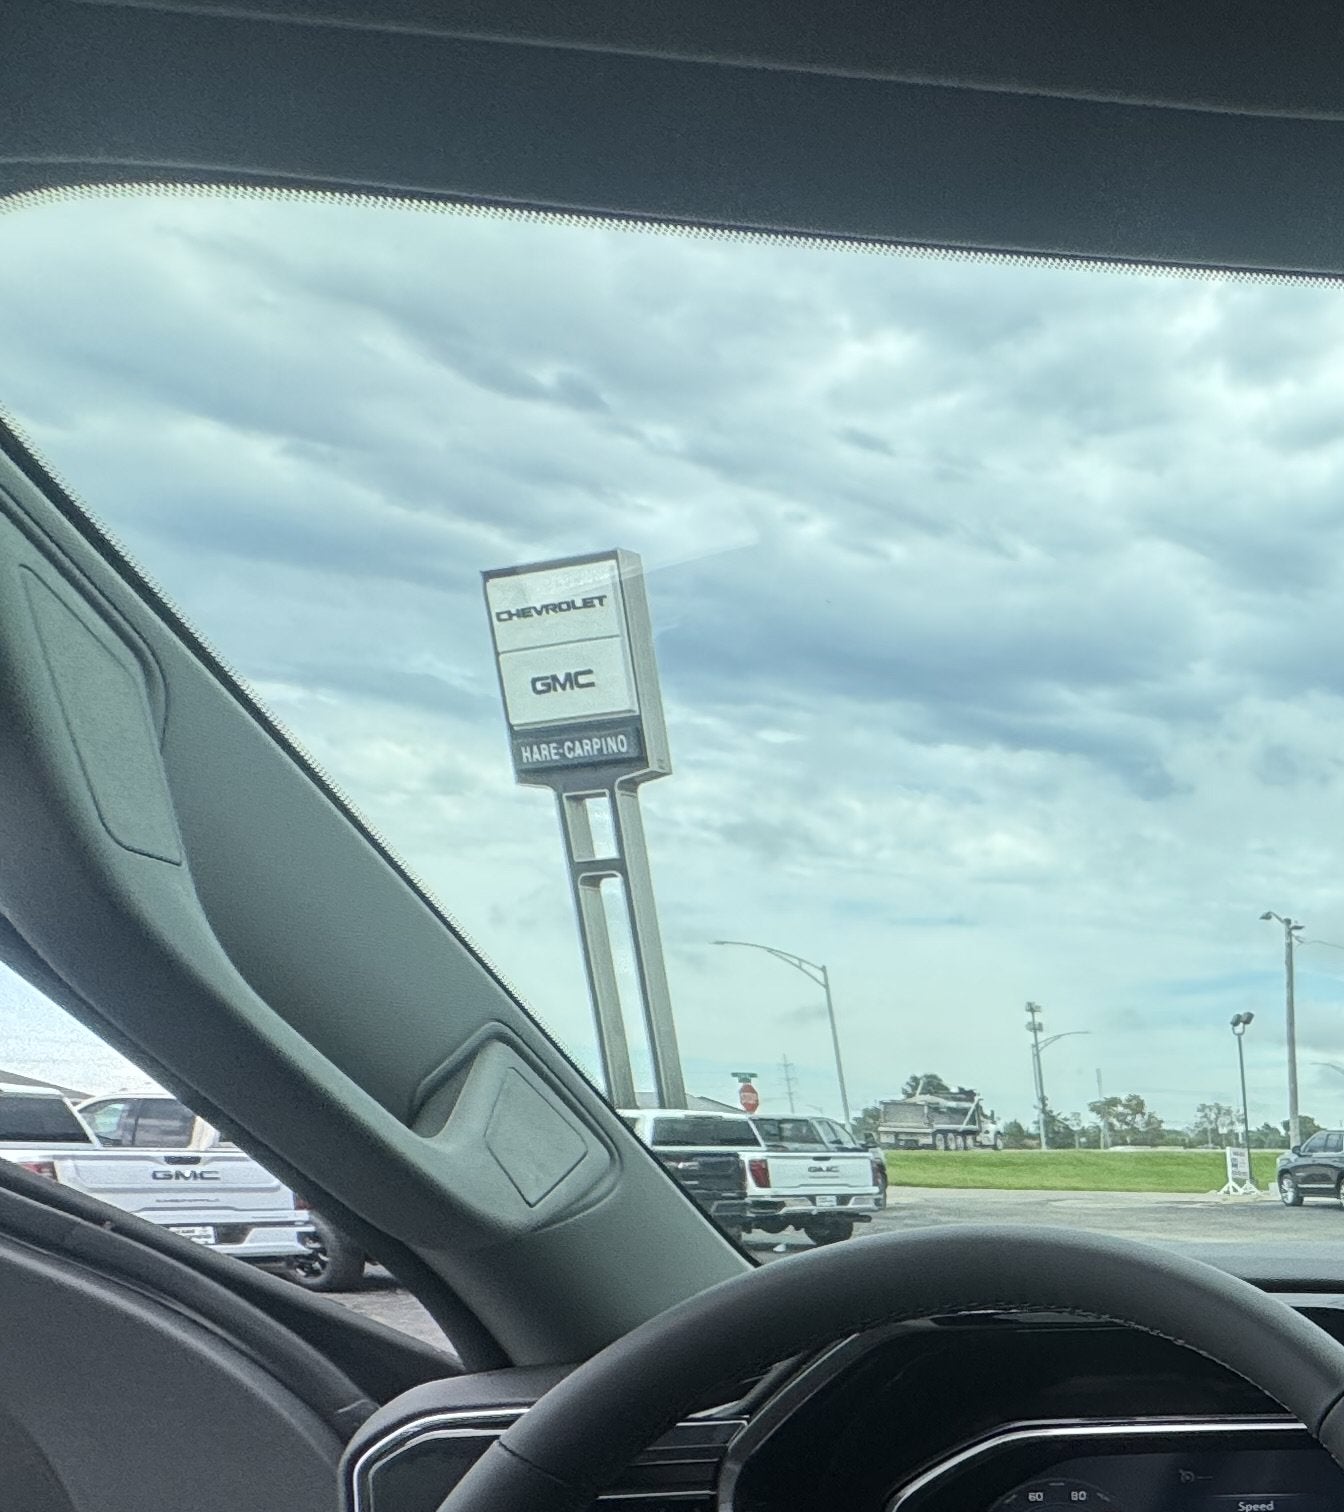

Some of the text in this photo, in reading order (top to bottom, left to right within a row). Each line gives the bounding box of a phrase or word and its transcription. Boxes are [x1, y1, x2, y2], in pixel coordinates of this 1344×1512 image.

[496, 594, 607, 622] CHEVROLET
[531, 668, 595, 695] GMC
[521, 733, 627, 763] HARE-CARPINO
[808, 1165, 840, 1173] GMC
[152, 1170, 221, 1181] GMC
[1028, 1492, 1044, 1502] 60
[1071, 1491, 1087, 1501] 80
